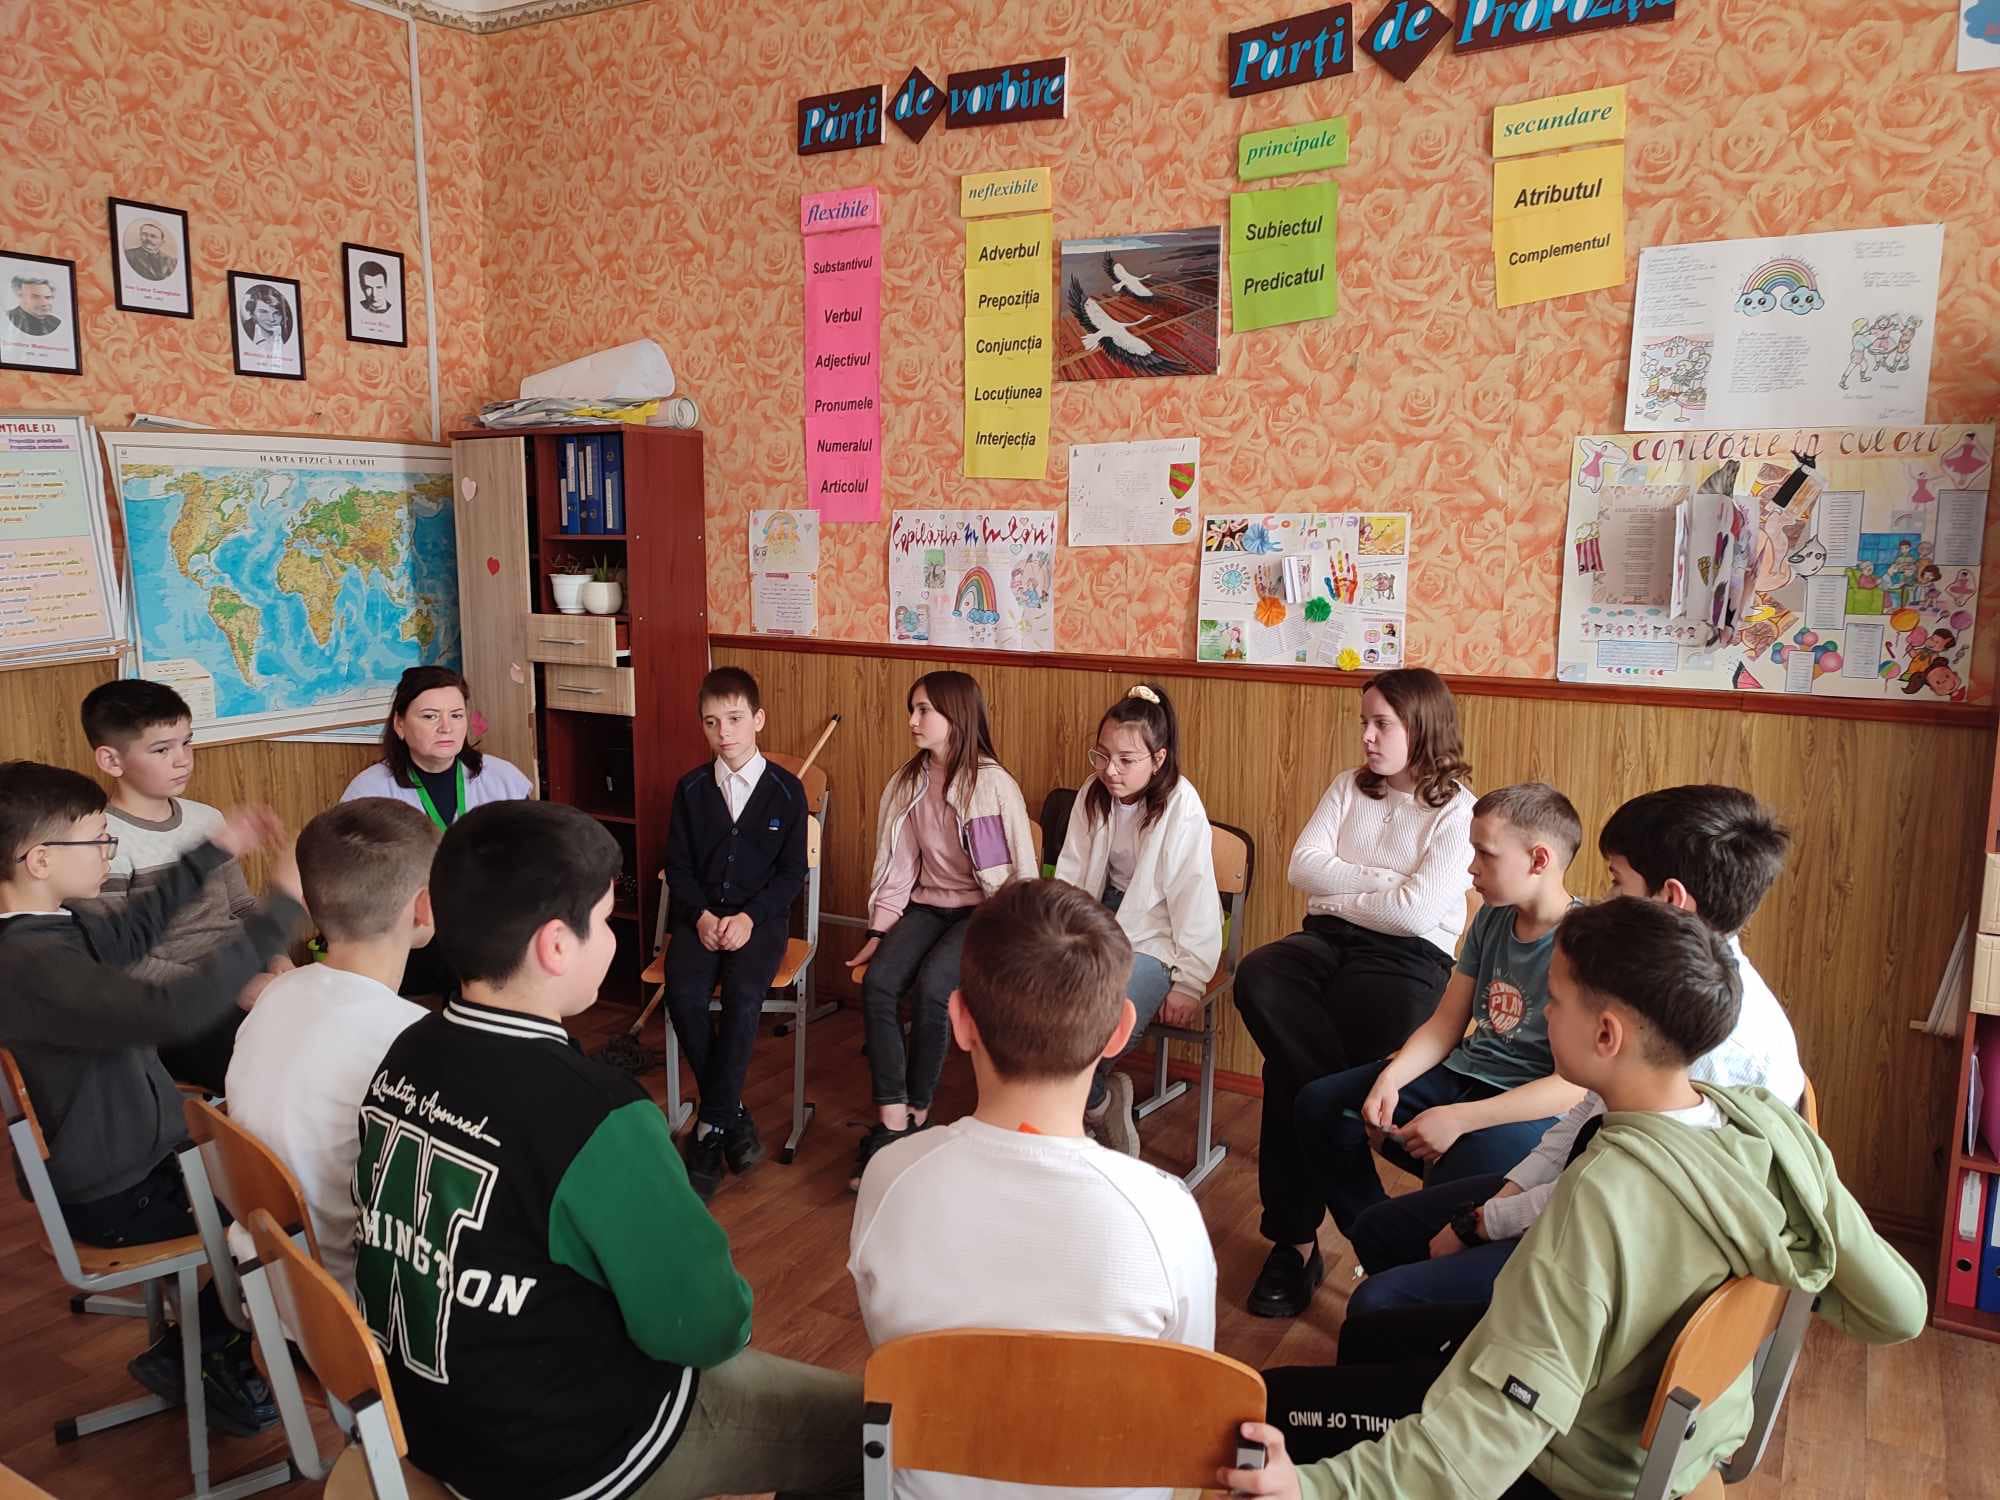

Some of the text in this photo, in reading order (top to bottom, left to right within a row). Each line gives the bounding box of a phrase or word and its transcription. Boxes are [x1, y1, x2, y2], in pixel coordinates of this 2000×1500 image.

[1373, 1, 1433, 53] de
[894, 78, 934, 121] de
[949, 68, 1065, 117] vorbire
[1503, 105, 1613, 137] secundare
[1246, 131, 1336, 165] principale
[968, 179, 1038, 201] neflexibile
[1513, 178, 1603, 209] Atributul
[805, 200, 869, 226] flexibile
[1245, 215, 1323, 241] Subiectul
[978, 240, 1040, 263] Adverbul
[1509, 233, 1610, 266] Complementul
[812, 256, 873, 274] Substantivul
[1243, 263, 1325, 296] Predicatul
[824, 307, 862, 323] Verbul
[815, 352, 870, 371] Adjectivul
[814, 396, 873, 413] Pronumele
[816, 438, 872, 453] Numeralul
[260, 455, 295, 464] HARTA
[820, 479, 868, 493] Articolul
[371, 1069, 417, 1115] Quality
[1288, 1411, 1323, 1428] MIND
[1327, 1413, 1347, 1429] OF
